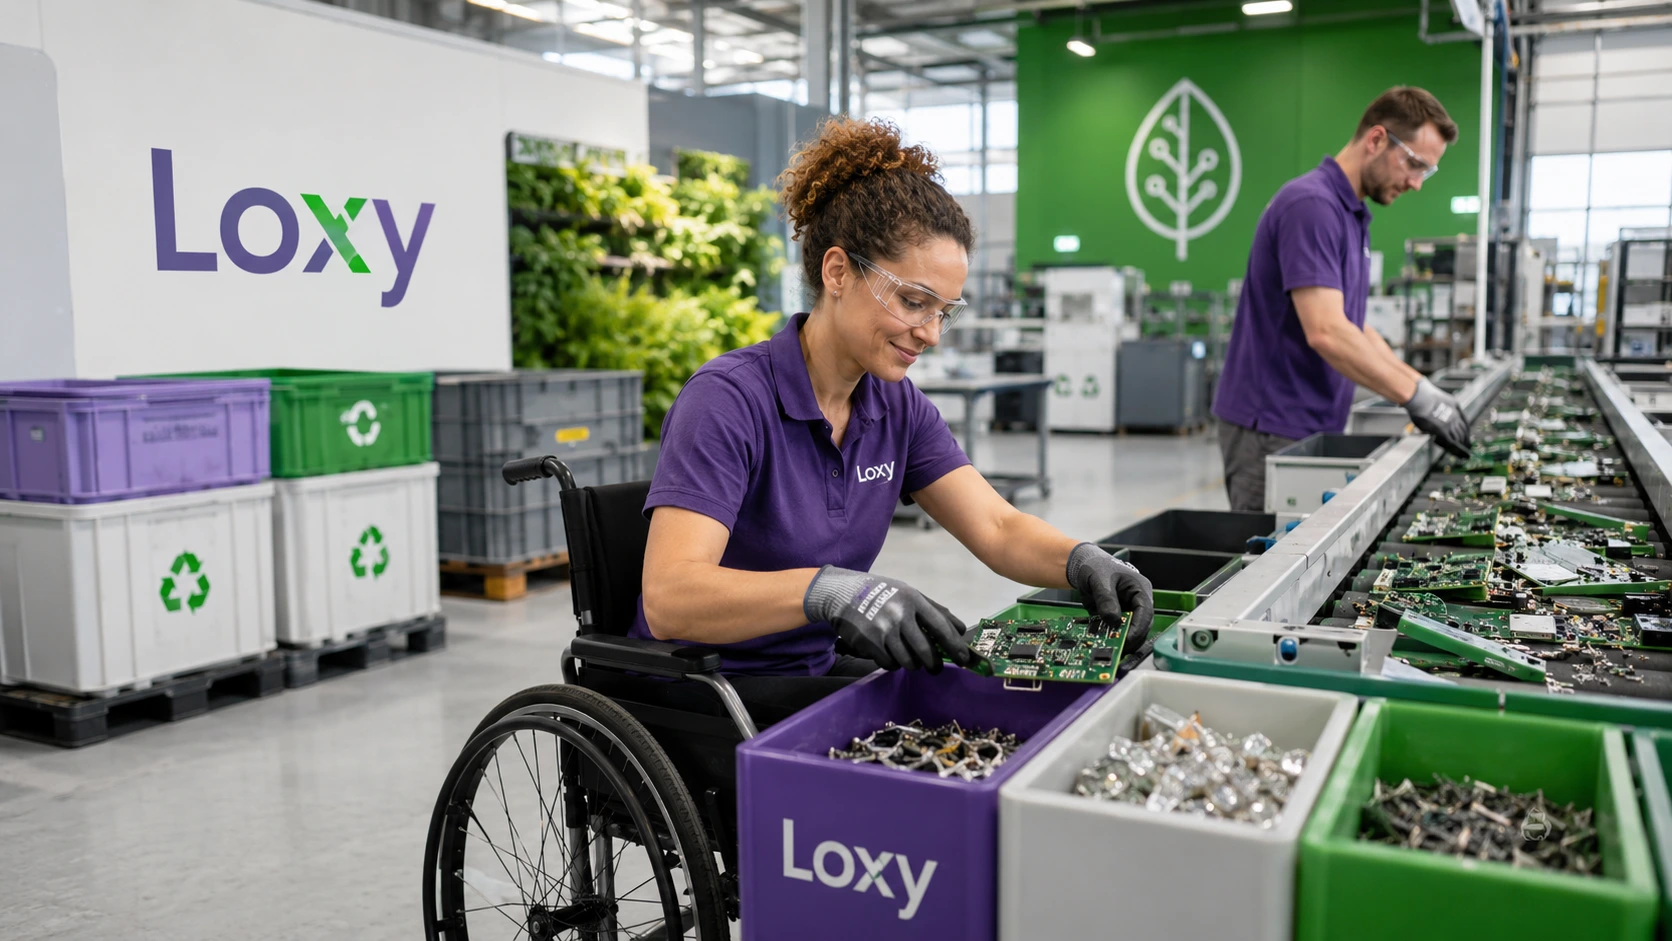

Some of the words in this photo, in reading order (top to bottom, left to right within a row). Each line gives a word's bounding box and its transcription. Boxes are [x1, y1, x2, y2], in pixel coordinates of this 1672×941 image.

[151, 147, 435, 308] Loxy
[857, 461, 895, 482] Loxy
[783, 818, 938, 920] Loxy
